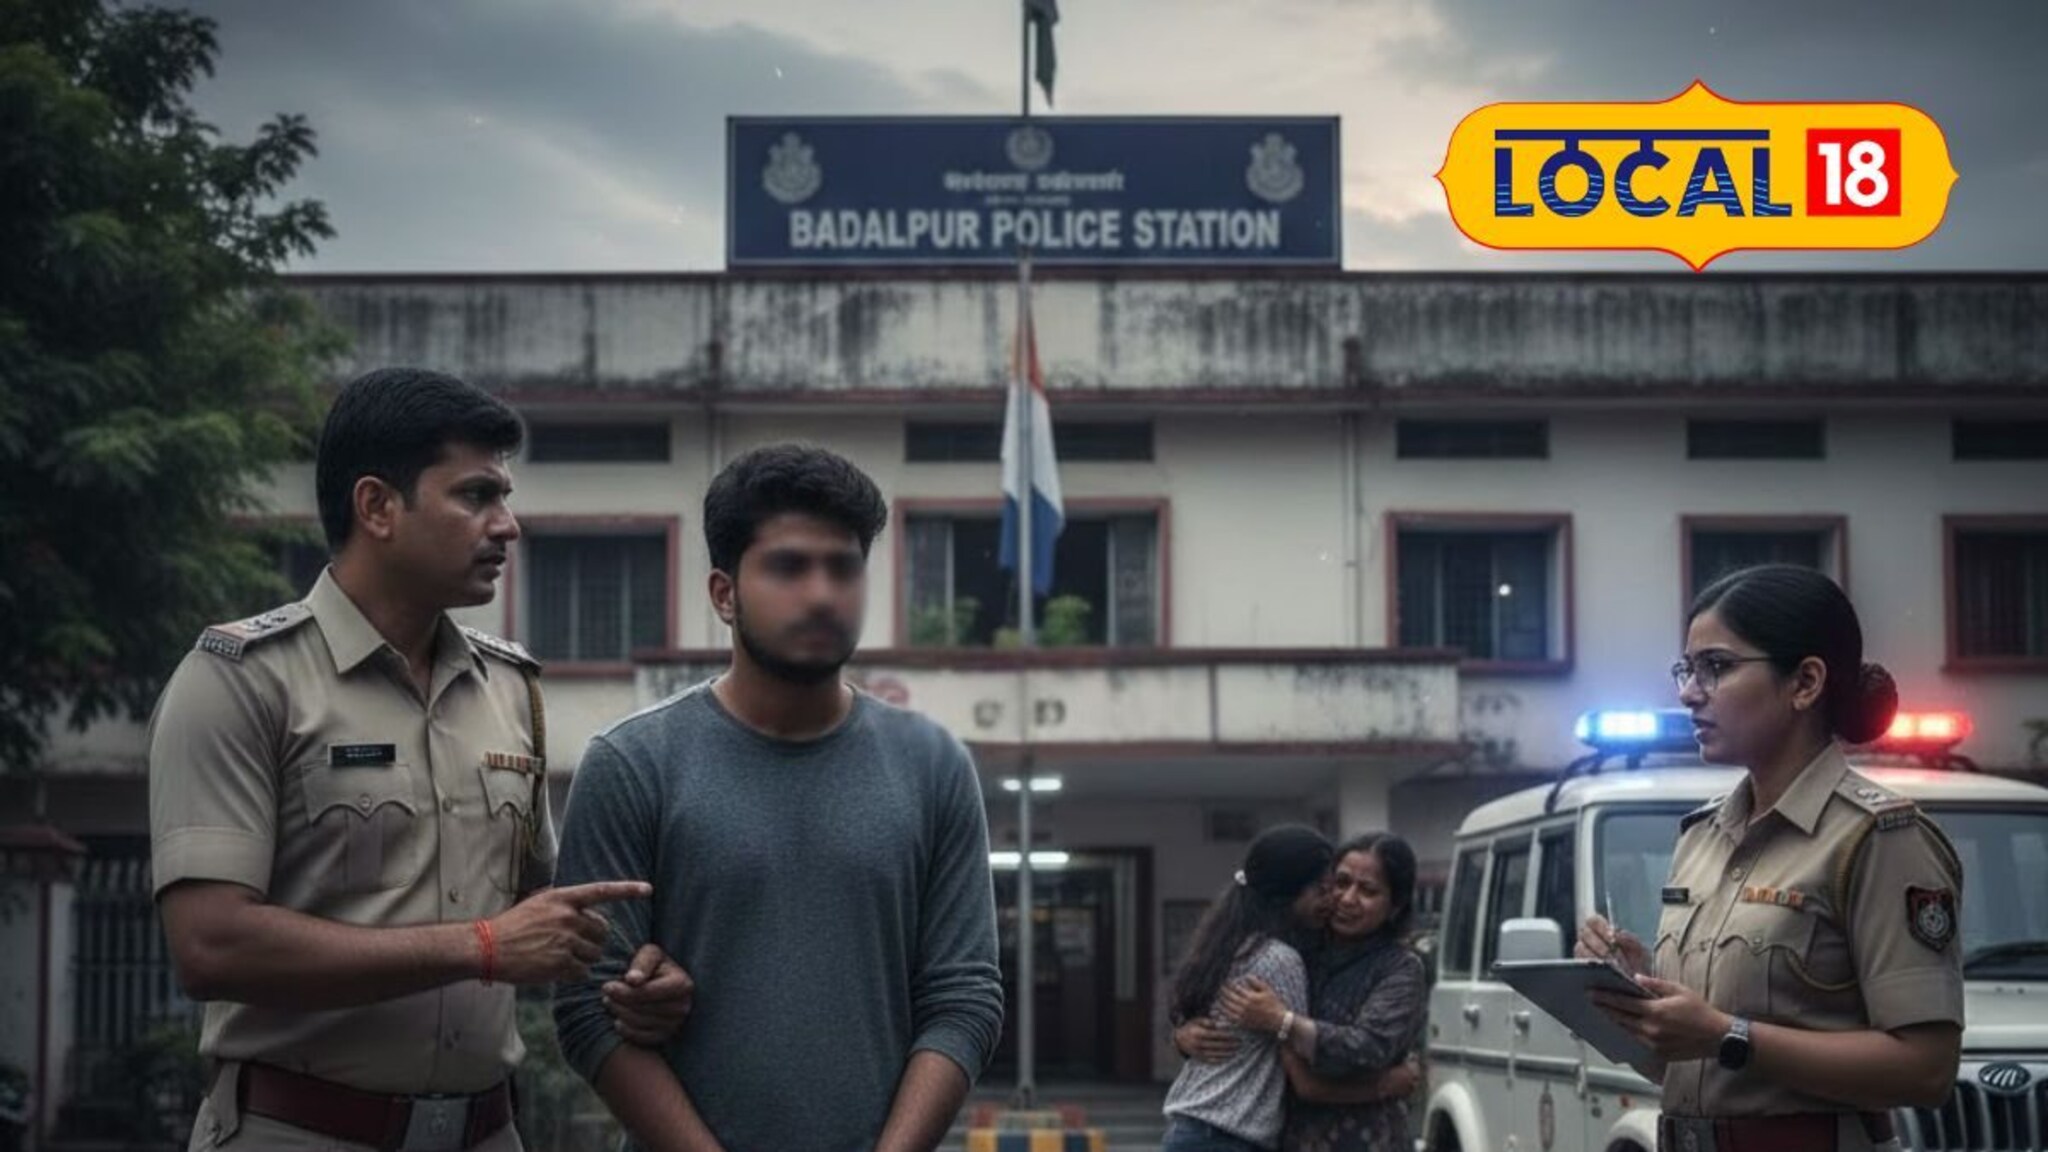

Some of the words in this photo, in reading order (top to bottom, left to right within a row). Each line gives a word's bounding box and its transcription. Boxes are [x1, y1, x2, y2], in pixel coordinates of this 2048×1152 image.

[790, 210, 979, 248] BADALPUR
[992, 210, 1120, 248] POLICE
[1134, 210, 1280, 248] STATION
